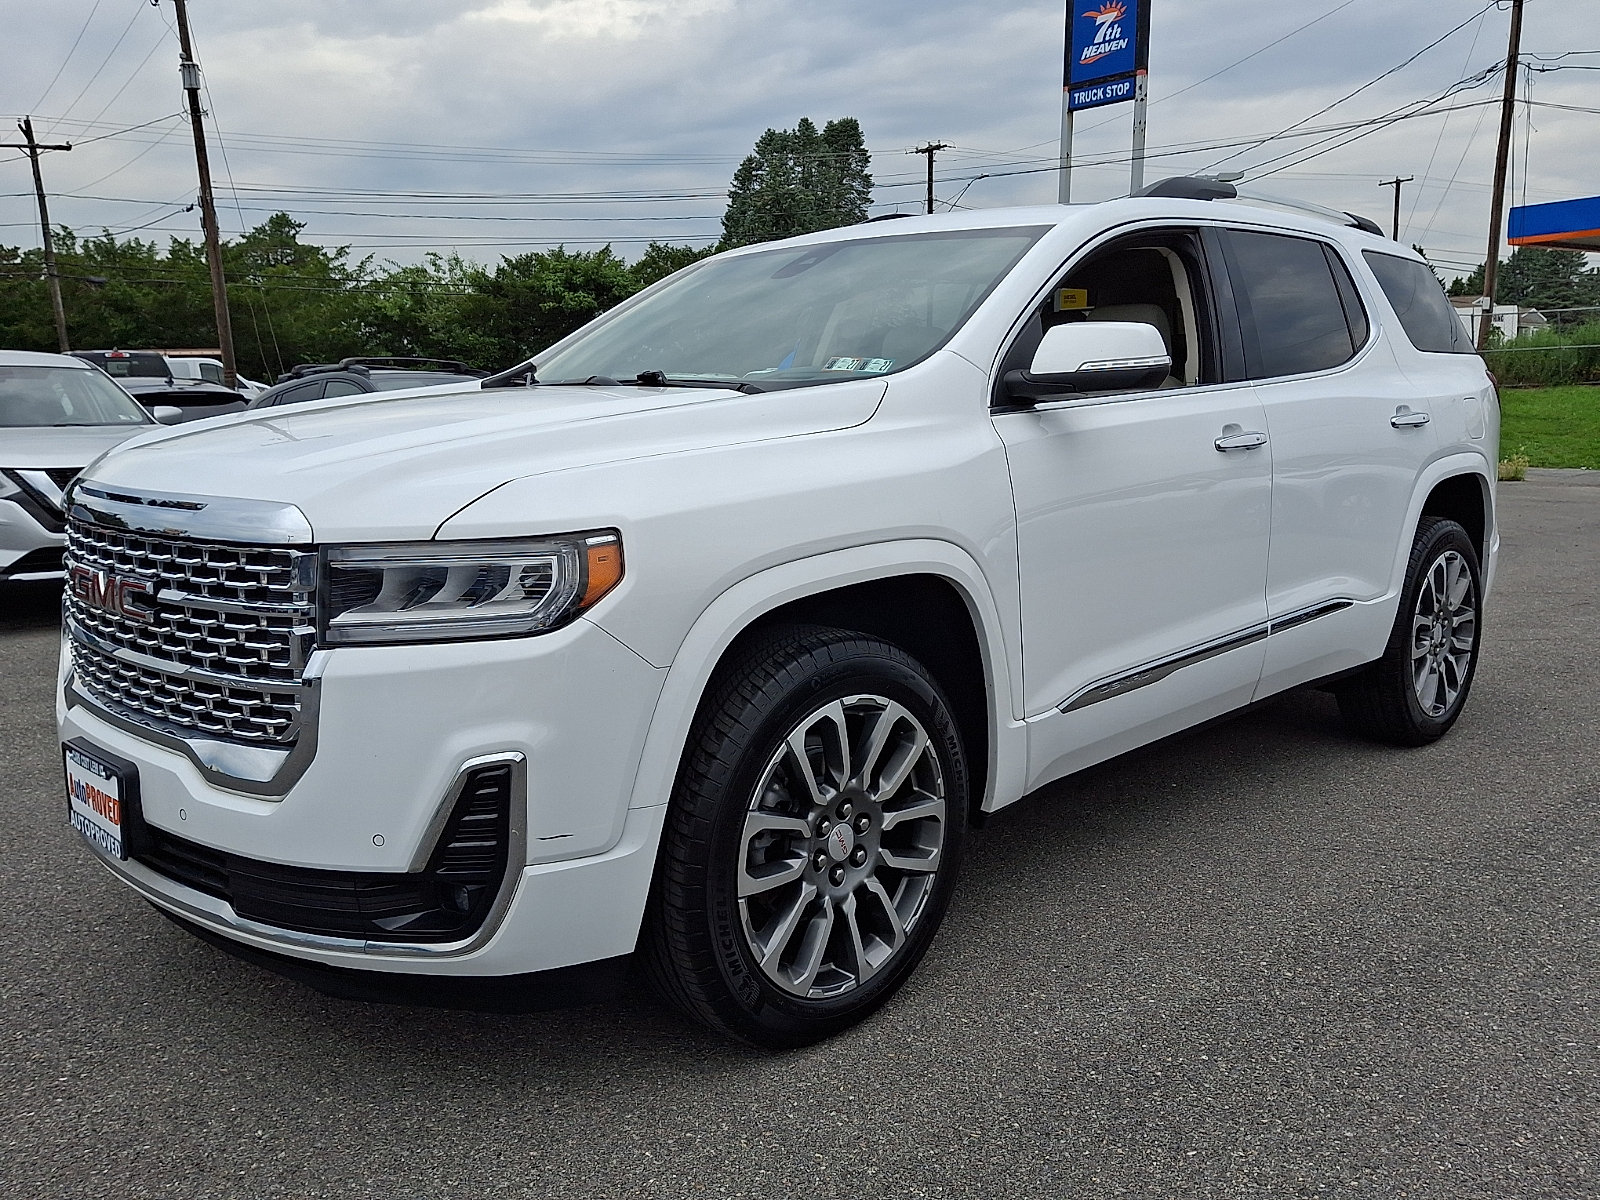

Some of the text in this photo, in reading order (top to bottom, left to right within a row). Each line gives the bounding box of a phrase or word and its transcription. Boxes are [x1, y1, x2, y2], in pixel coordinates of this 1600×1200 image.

[1094, 11, 1121, 44] 7th
[1081, 38, 1128, 60] HEAVEN
[1074, 82, 1130, 104] TRUCK STOP
[72, 565, 154, 623] GMC
[68, 771, 121, 826] AutoPROVED
[70, 809, 121, 859] AUTOPROVED
